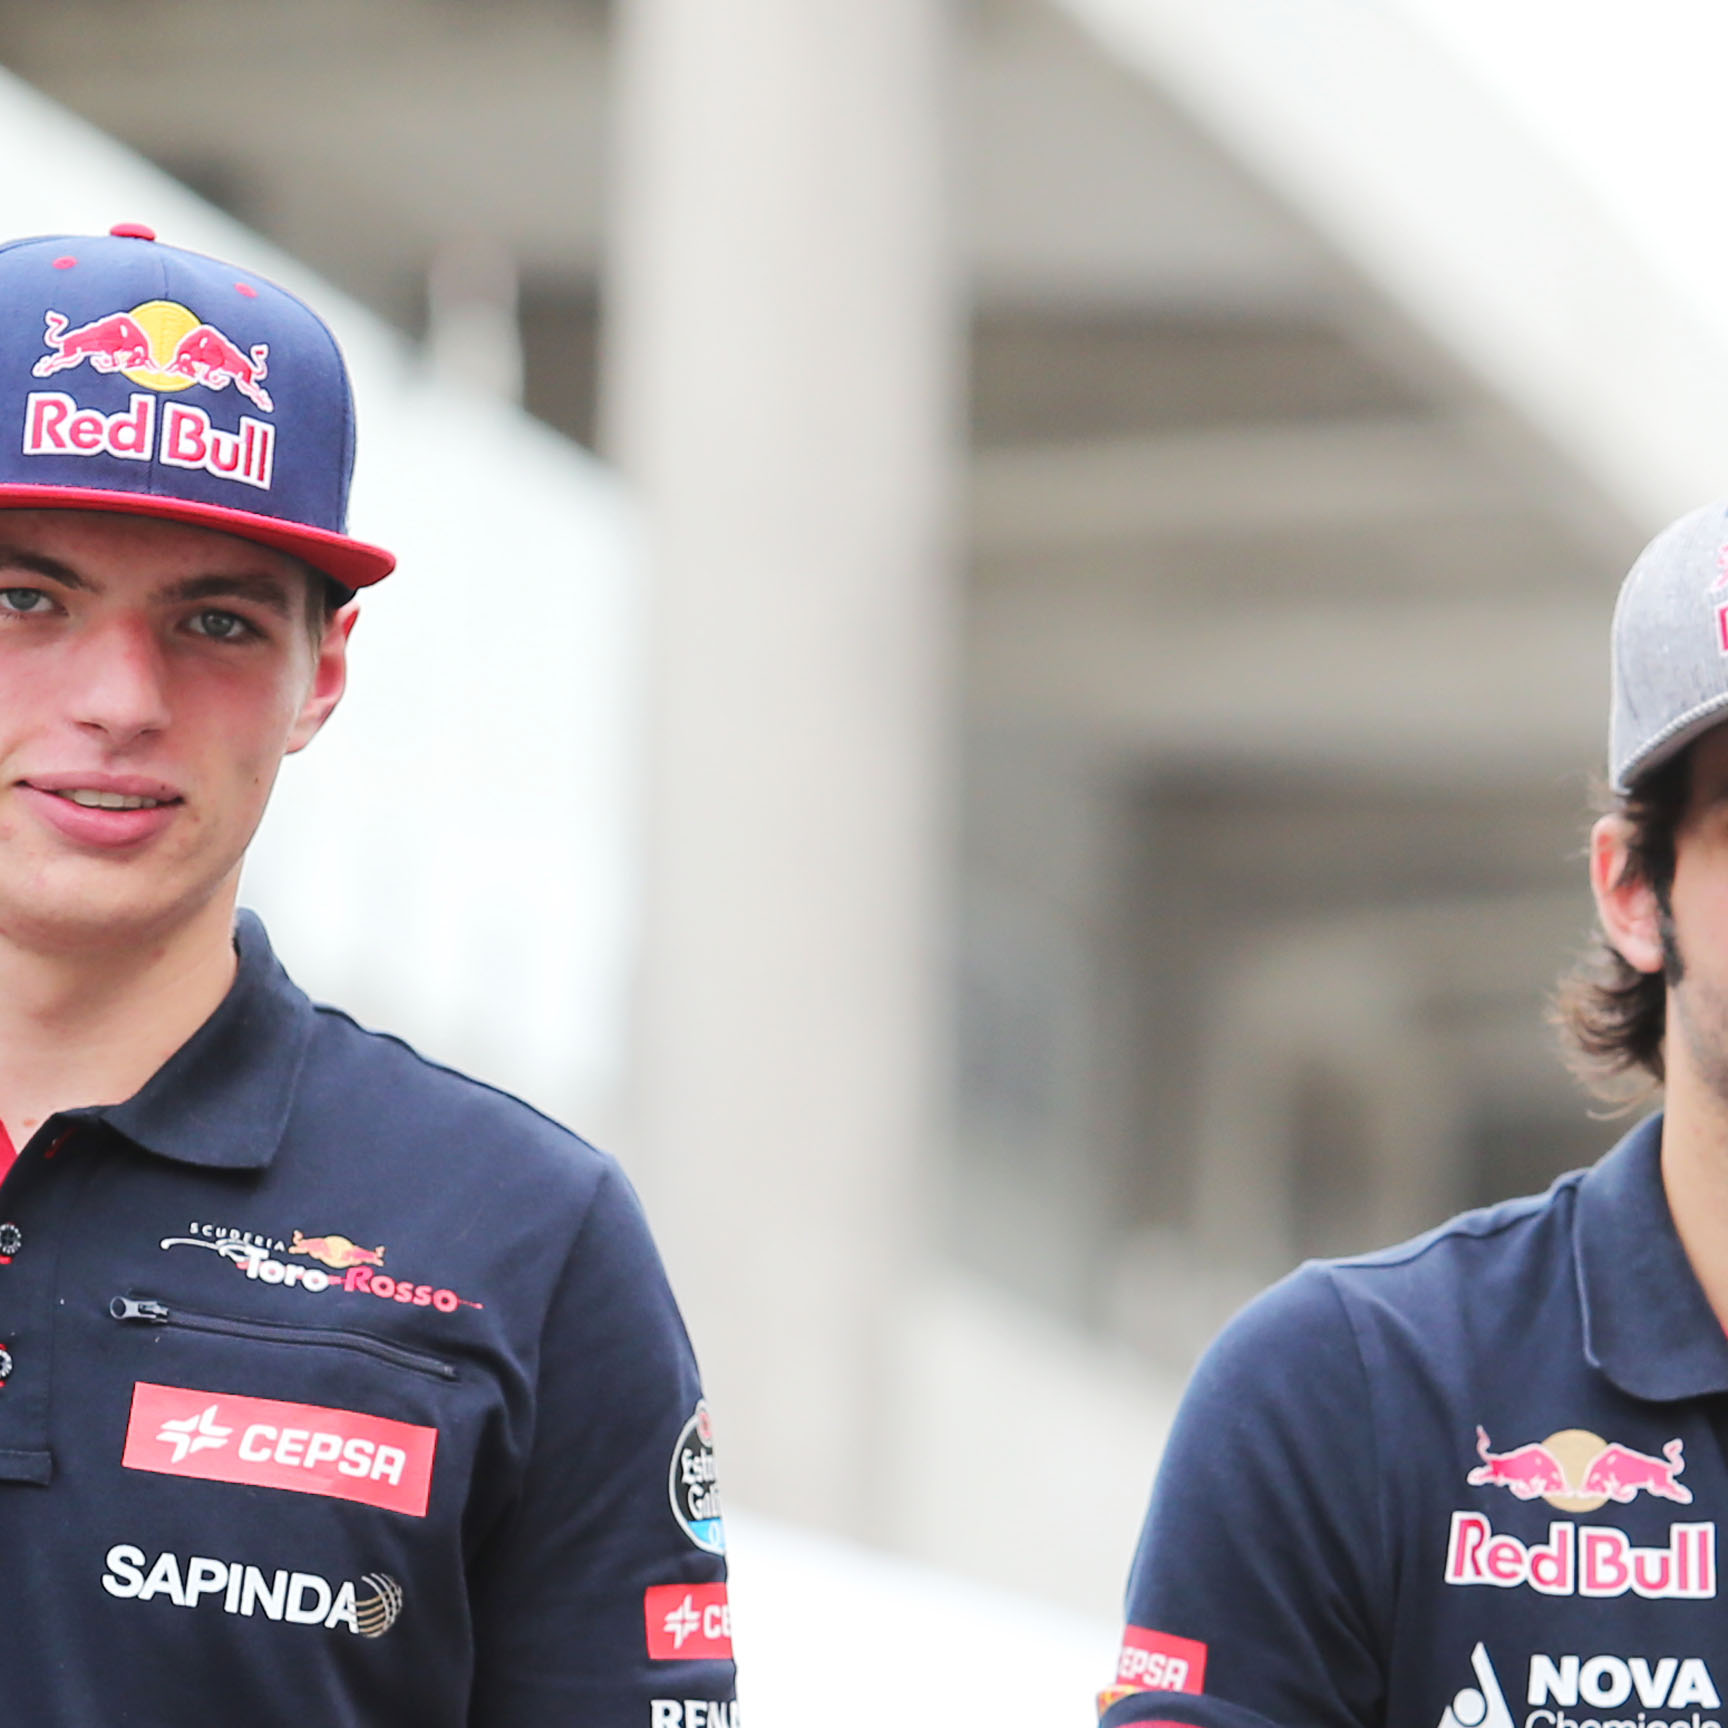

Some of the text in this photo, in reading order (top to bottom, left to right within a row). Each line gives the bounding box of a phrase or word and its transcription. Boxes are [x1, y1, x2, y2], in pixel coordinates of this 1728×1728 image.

[26, 394, 272, 487] Red Bull
[189, 1221, 286, 1252] SCUDERIA
[237, 1423, 407, 1487] CEPSA
[100, 1543, 360, 1635] SAPINDA
[1447, 1513, 1715, 1597] Red Bull
[1526, 1653, 1722, 1709] NOVA
